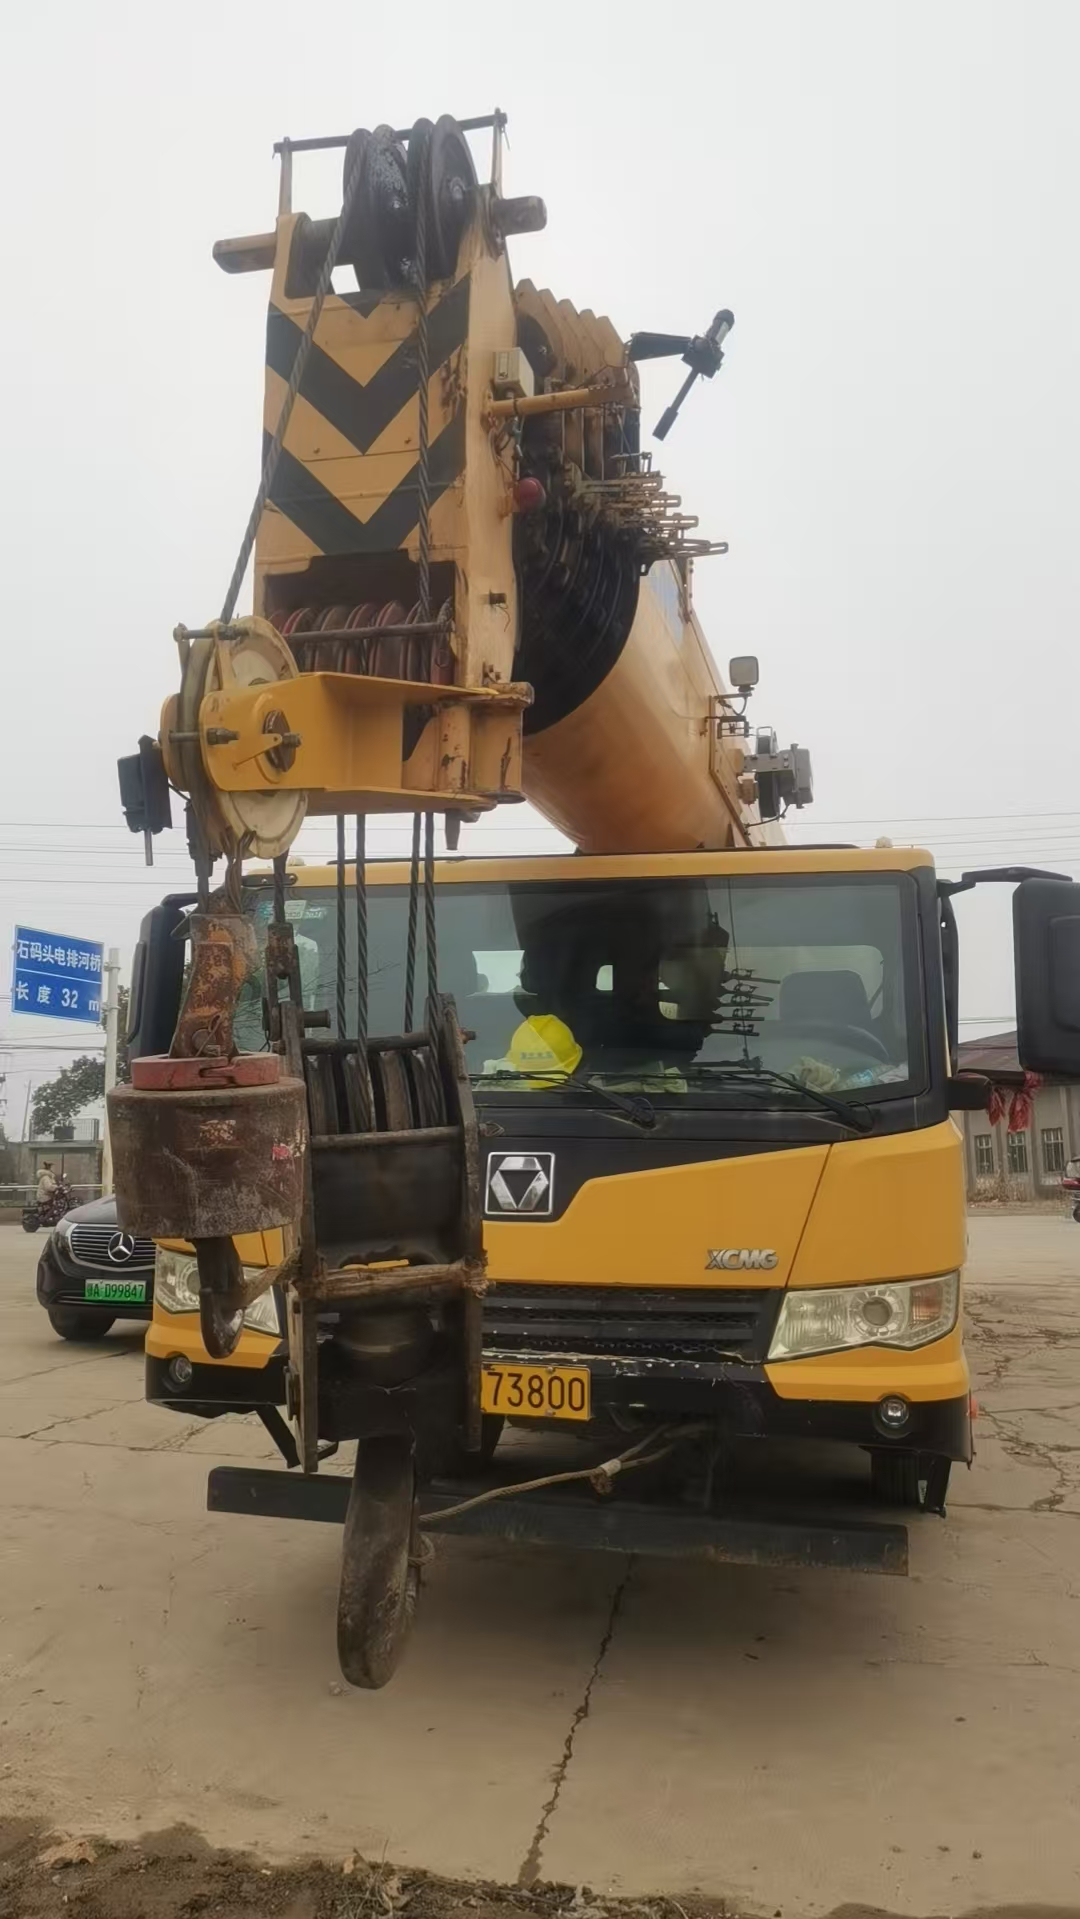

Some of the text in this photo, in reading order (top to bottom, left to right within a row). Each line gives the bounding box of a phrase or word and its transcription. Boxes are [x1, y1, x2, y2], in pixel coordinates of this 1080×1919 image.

[17, 940, 101, 972] 石码头电排河桥
[62, 988, 78, 1008] 32
[88, 1000, 99, 1011] m
[704, 1249, 779, 1270] XCMG
[487, 1371, 585, 1411] 73800
